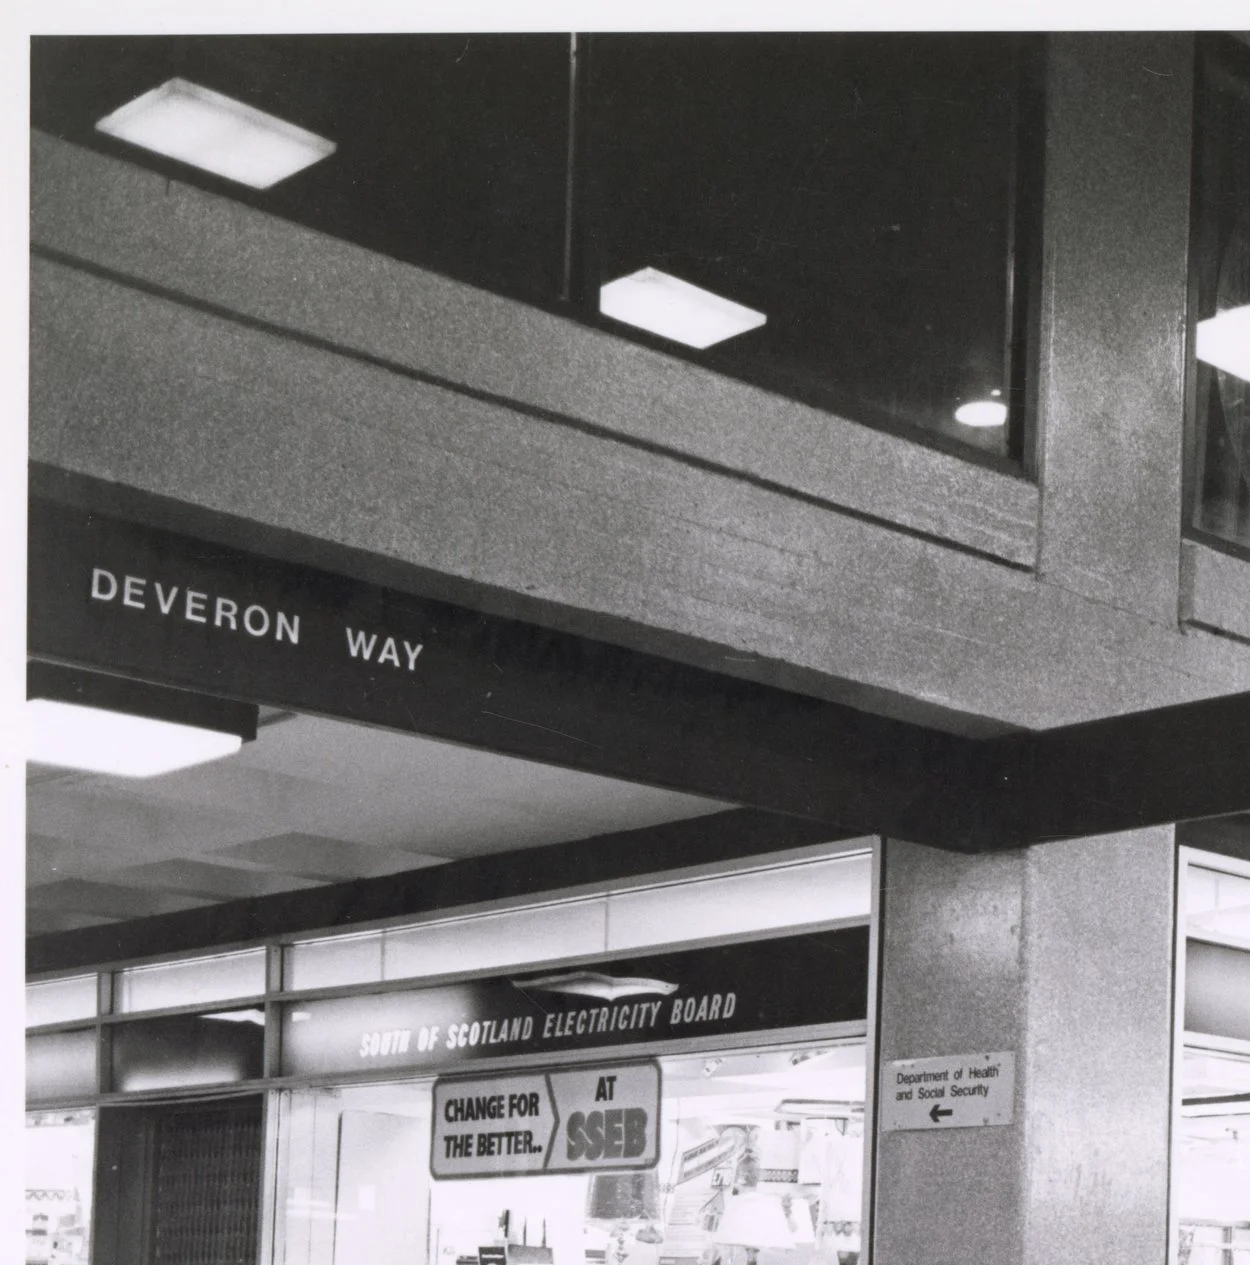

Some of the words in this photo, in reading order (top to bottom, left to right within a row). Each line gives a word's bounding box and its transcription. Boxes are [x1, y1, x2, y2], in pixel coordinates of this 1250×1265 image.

[91, 568, 300, 645] DEVERON
[346, 627, 424, 671] WAY
[359, 1026, 411, 1058] SOUTH
[417, 1025, 439, 1051] OF
[446, 1017, 534, 1050] SCOTLAND
[543, 1001, 662, 1038] ELECTRICITY
[671, 993, 736, 1024] BOARD
[595, 1076, 617, 1101] AT
[896, 1069, 949, 1086] Department
[953, 1068, 963, 1080] of
[969, 1066, 999, 1079] Health
[896, 1090, 912, 1101] and
[918, 1087, 945, 1100] Social
[950, 1084, 989, 1098] Security
[445, 1095, 505, 1122] CHANGE
[508, 1092, 540, 1118] FOR
[444, 1134, 473, 1159] THE
[566, 1107, 648, 1162] SSEB
